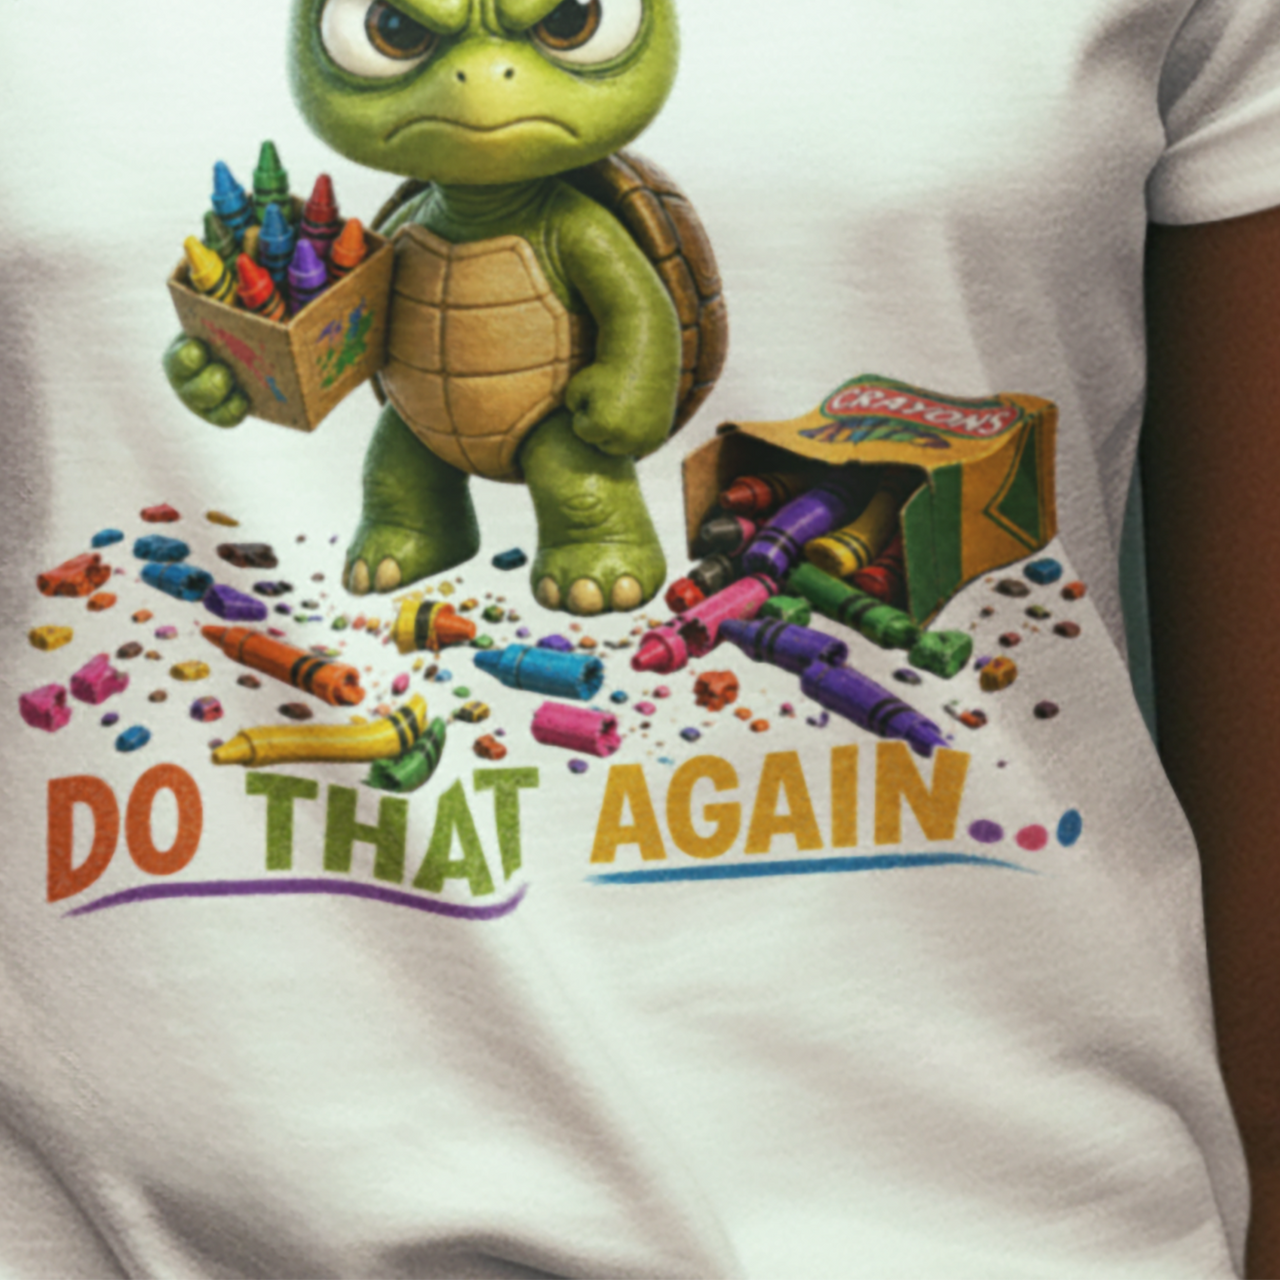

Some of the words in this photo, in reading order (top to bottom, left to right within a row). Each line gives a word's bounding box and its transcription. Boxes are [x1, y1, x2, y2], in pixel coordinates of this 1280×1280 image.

[830, 387, 1011, 436] CRAYONS
[46, 762, 205, 905] DO
[244, 765, 541, 897] THAT
